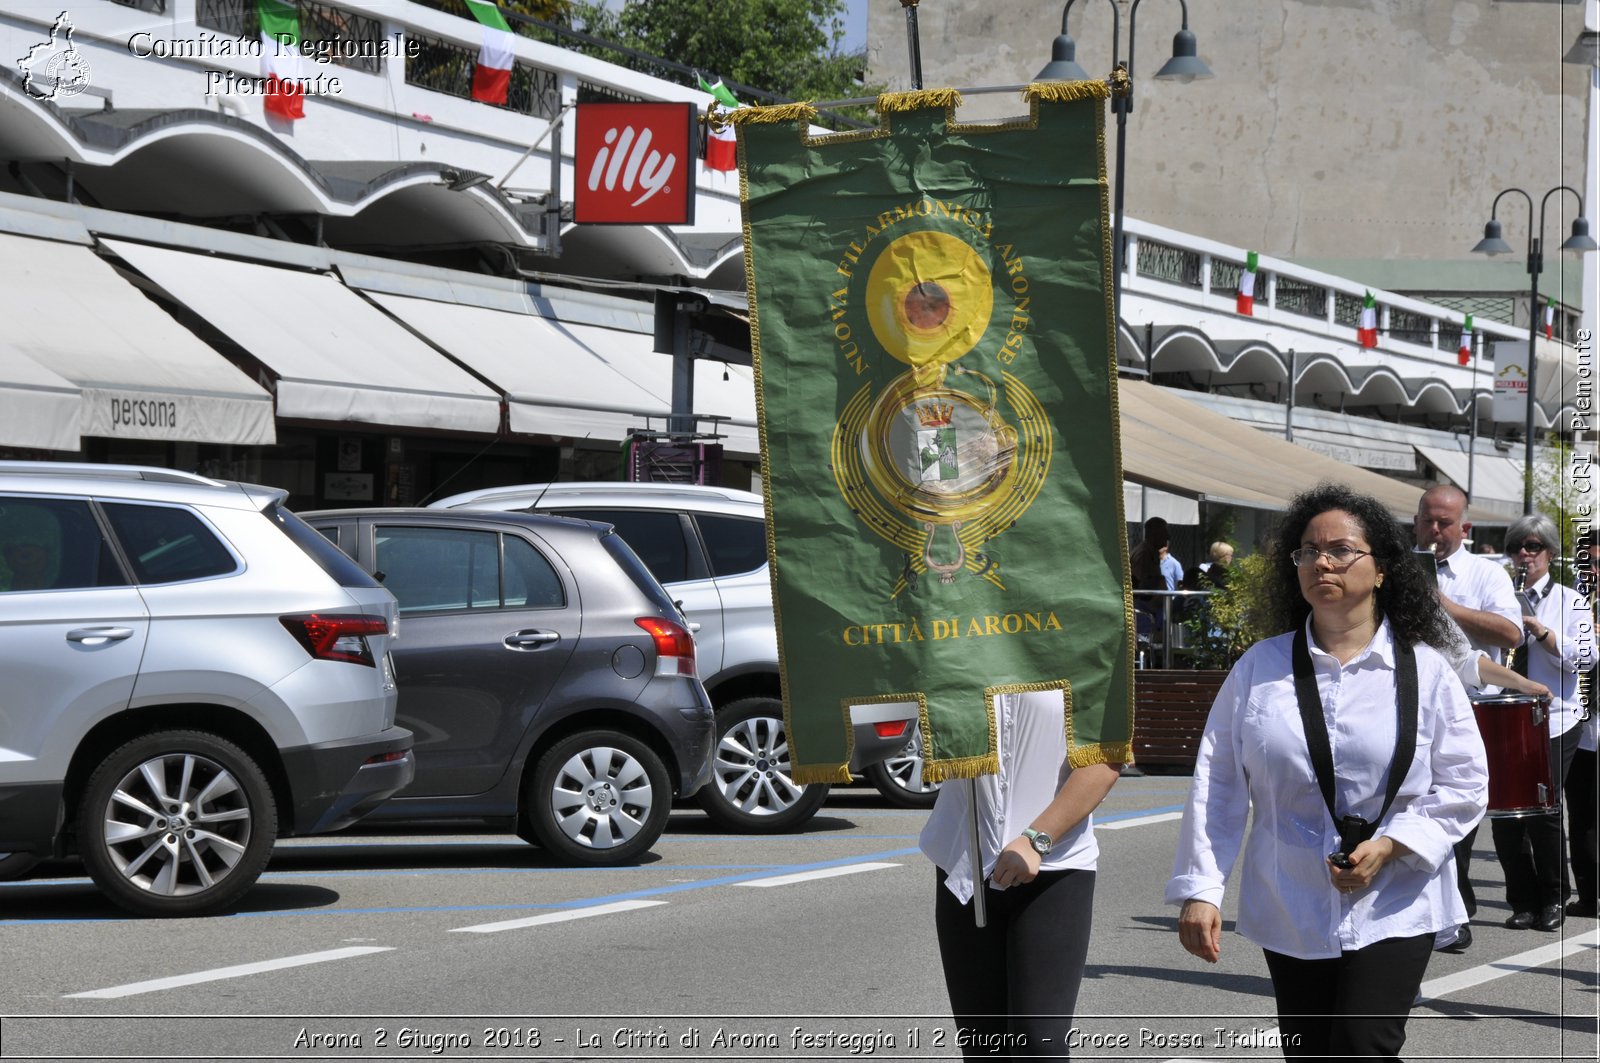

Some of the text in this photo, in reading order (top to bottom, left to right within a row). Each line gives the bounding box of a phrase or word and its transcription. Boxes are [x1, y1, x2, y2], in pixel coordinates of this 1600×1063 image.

[588, 125, 676, 207] illy
[831, 199, 1032, 375] NUOVA FILARMONICA ARONESE
[111, 398, 176, 430] persona
[842, 611, 1063, 647] CITTÀ DI ARONA
